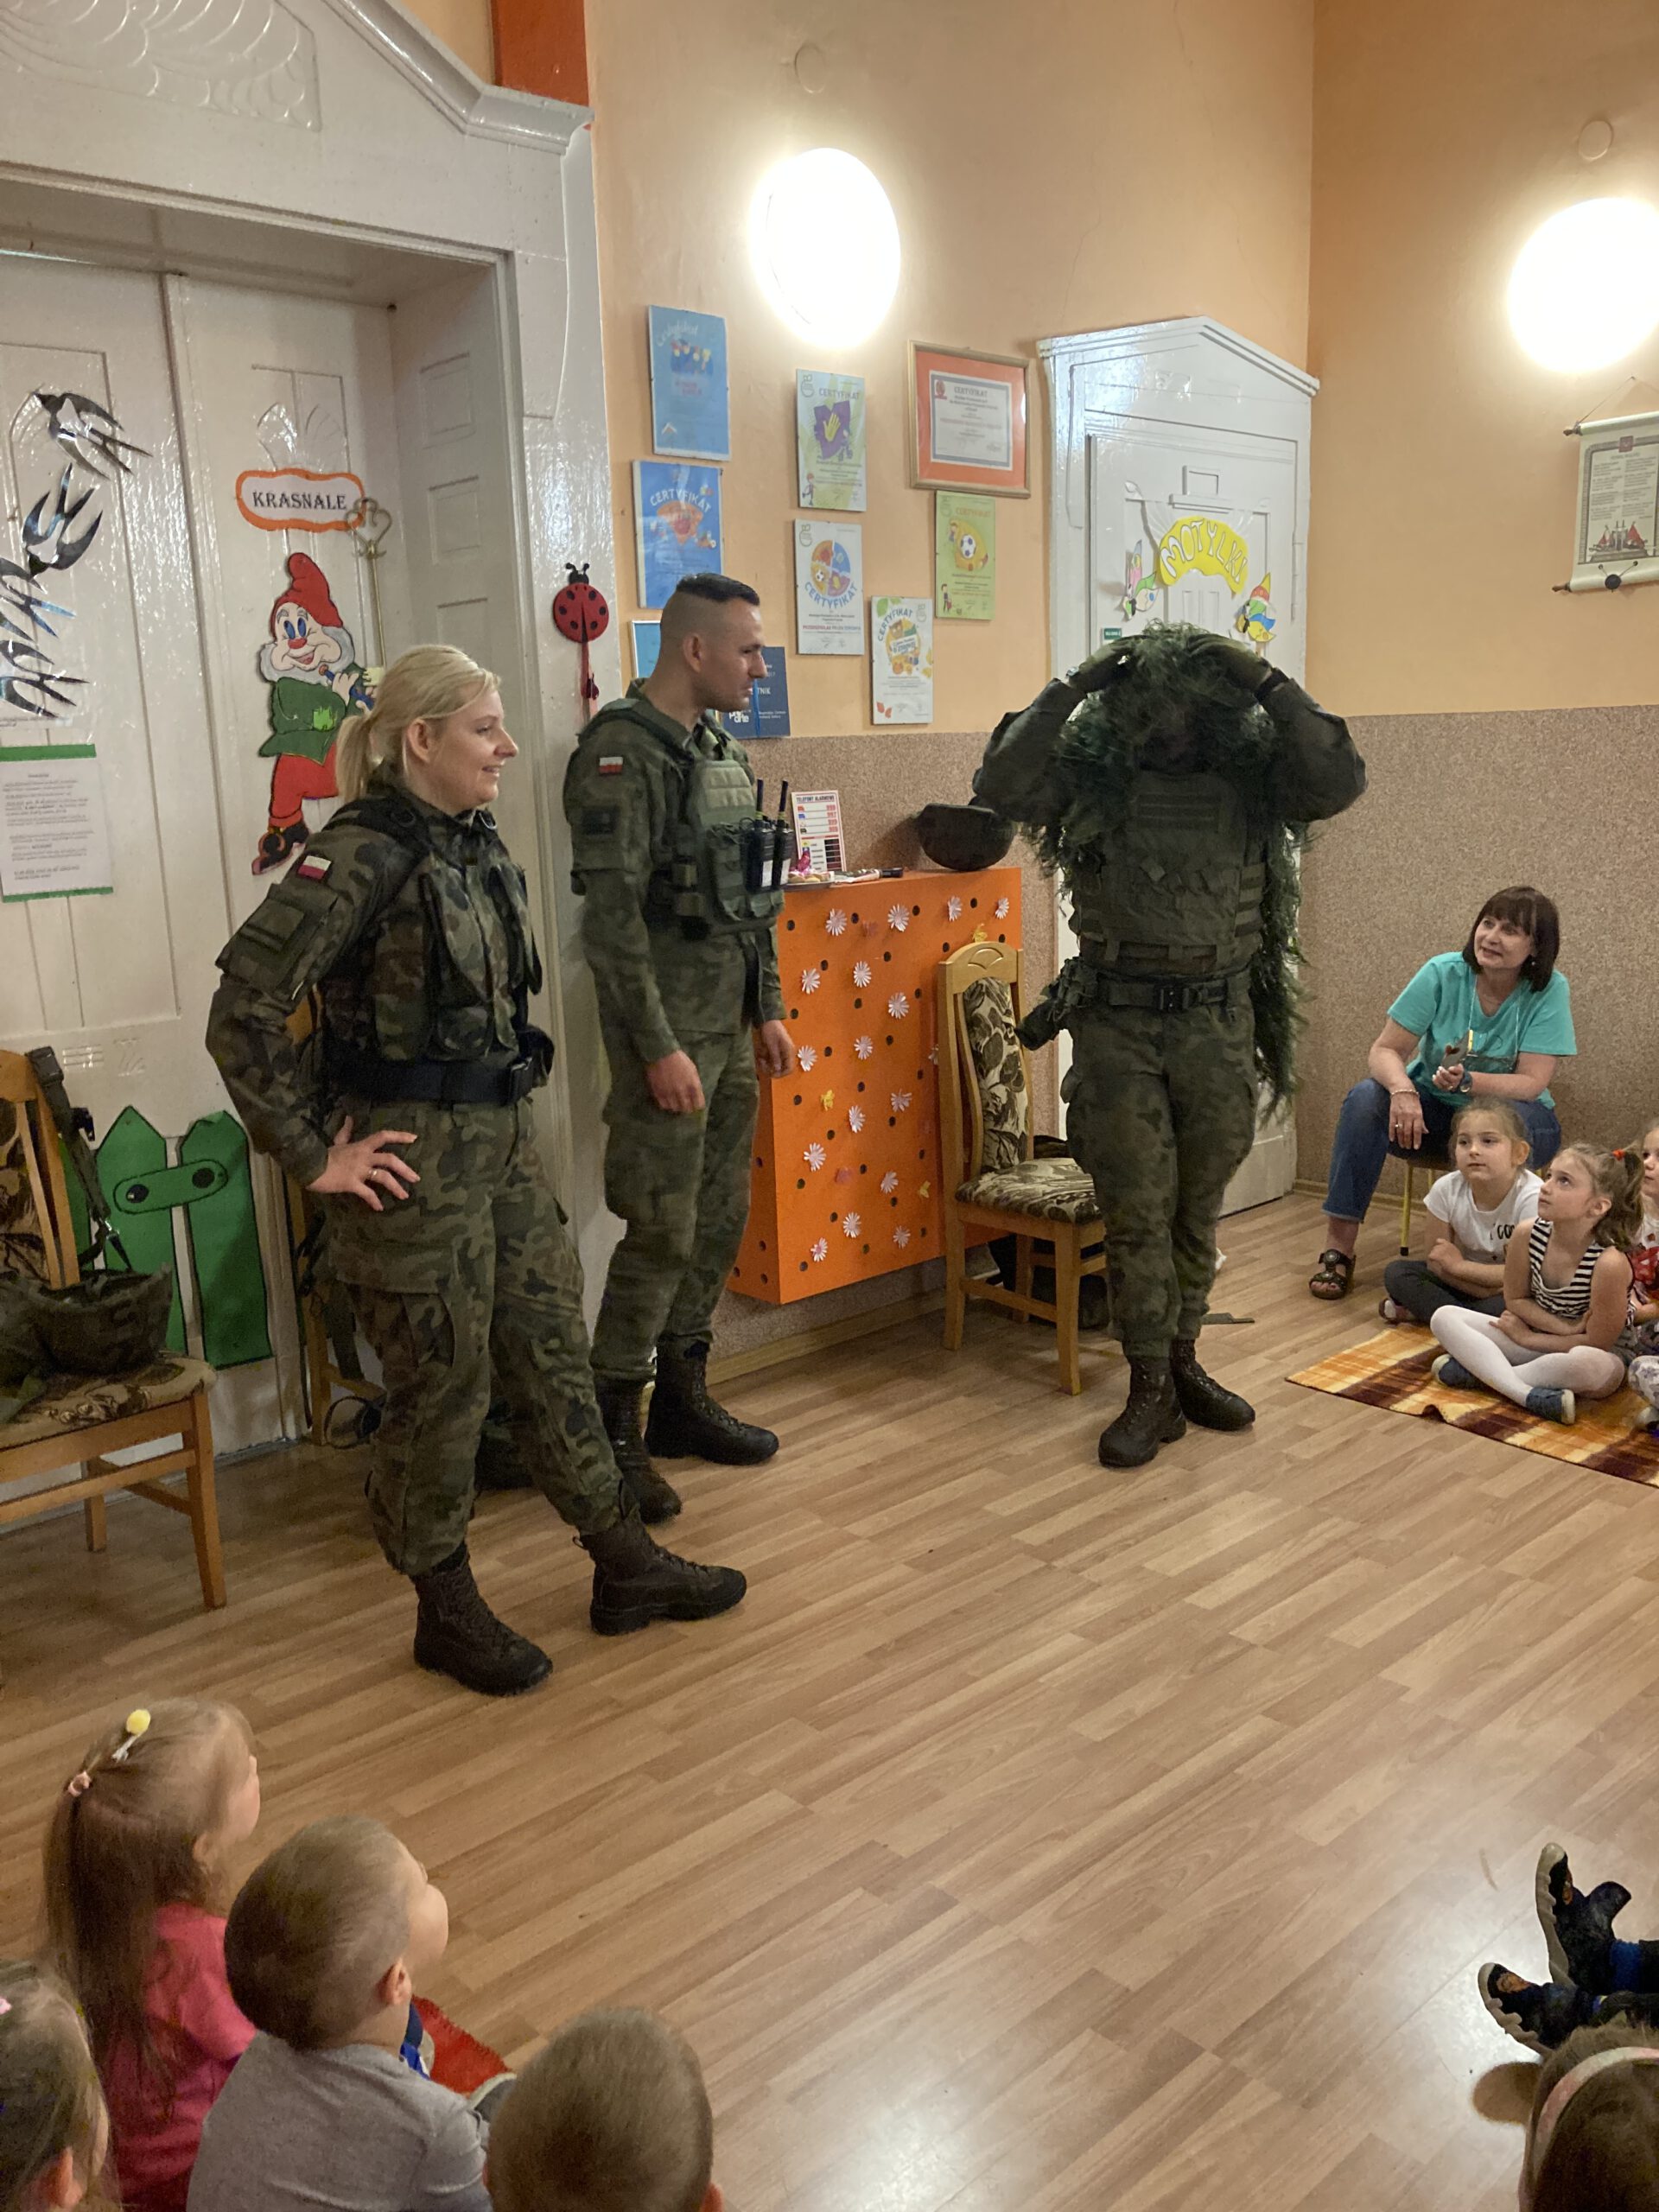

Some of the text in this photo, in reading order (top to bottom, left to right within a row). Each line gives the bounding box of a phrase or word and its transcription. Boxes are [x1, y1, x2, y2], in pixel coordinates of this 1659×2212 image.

[252, 490, 347, 511] KRASNALE
[650, 488, 711, 513] CERTYFIKAT
[1160, 518, 1248, 585] MOTYLKI
[804, 582, 858, 609] CERTYFIKAT
[878, 608, 913, 642] CERTYFIKAT
